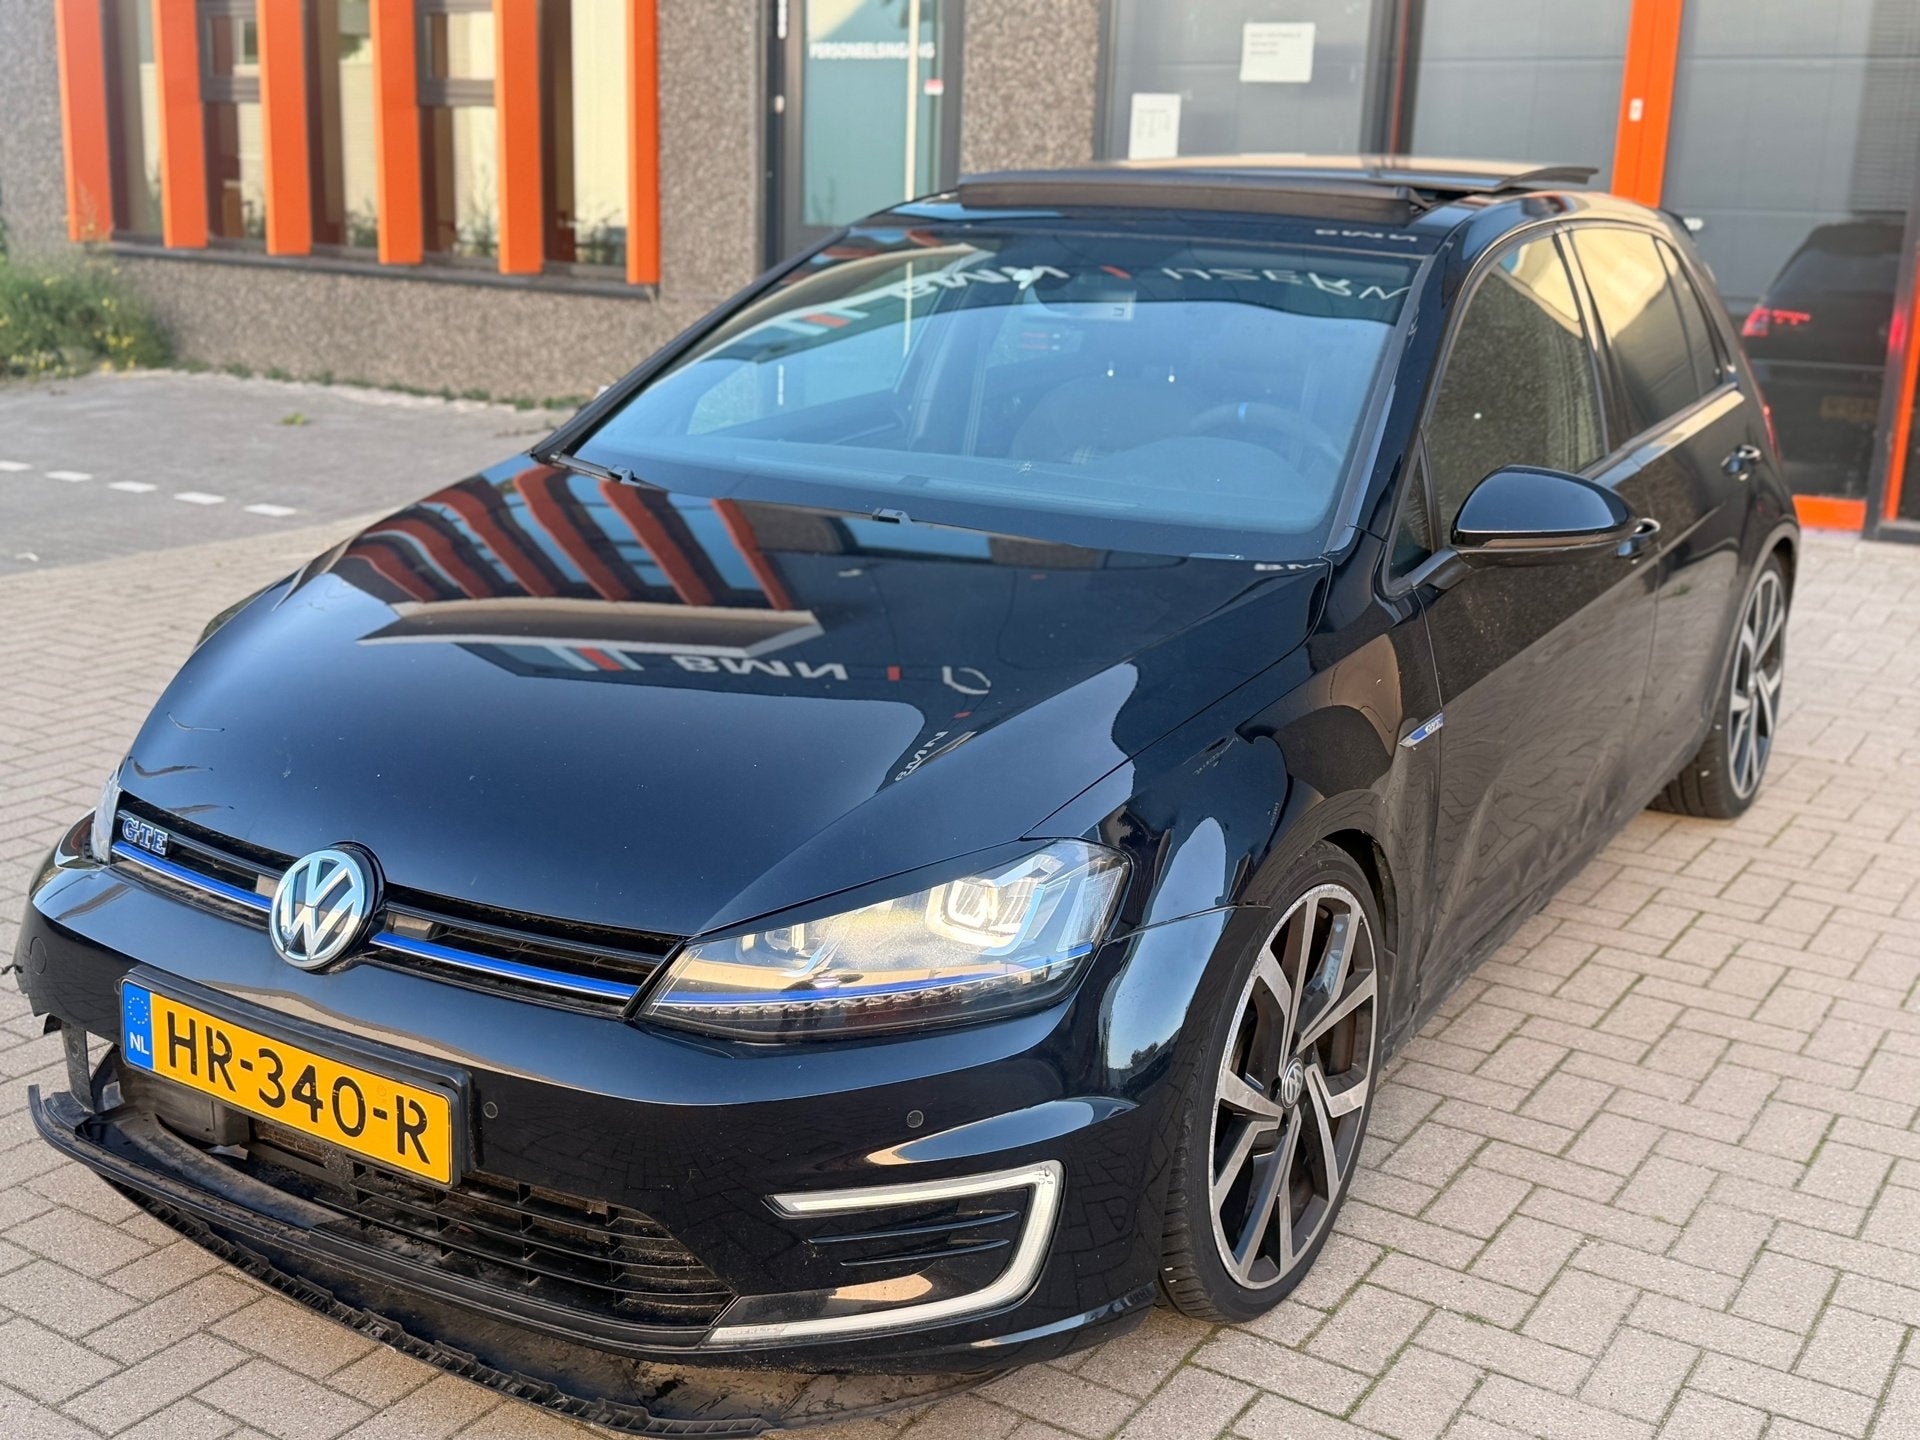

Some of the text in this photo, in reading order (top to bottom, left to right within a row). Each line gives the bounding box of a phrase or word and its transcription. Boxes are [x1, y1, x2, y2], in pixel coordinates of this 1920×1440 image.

[808, 41, 936, 60] PERSONEELSINGNG
[122, 817, 169, 856] GTE
[128, 1031, 150, 1055] NL
[166, 1010, 431, 1165] HR-340-R
